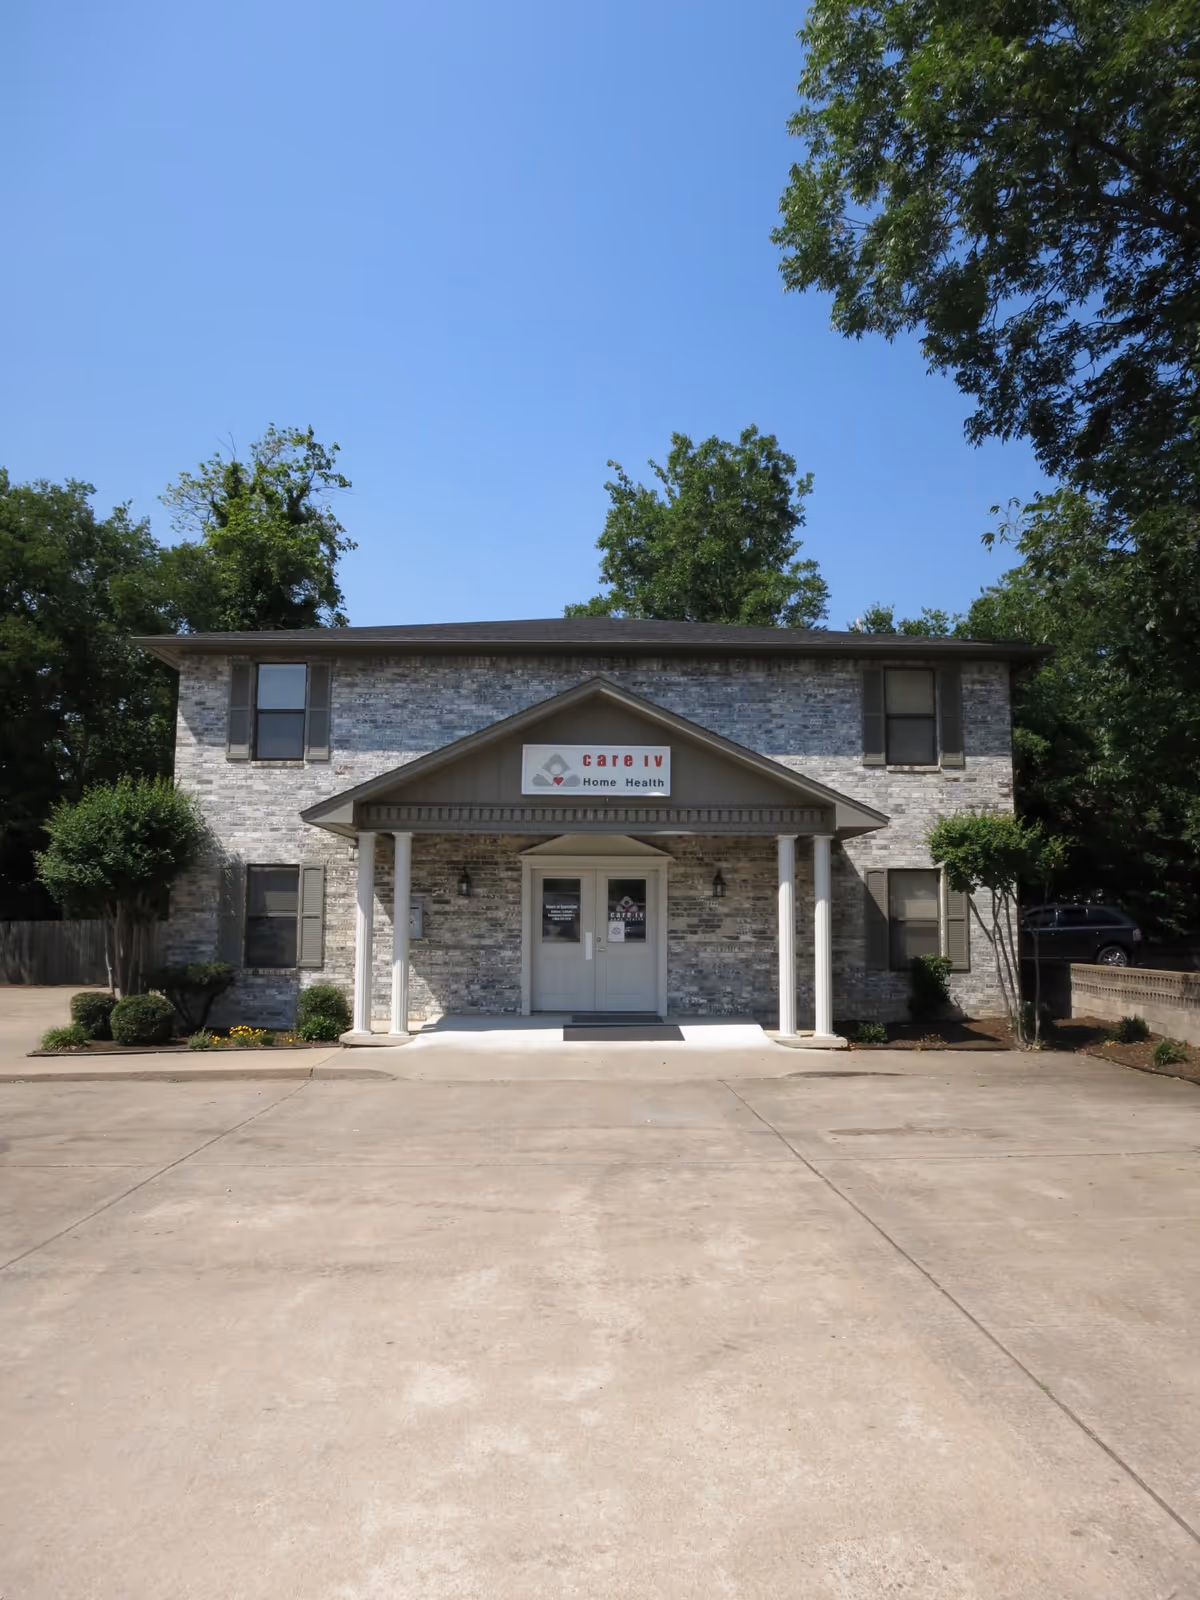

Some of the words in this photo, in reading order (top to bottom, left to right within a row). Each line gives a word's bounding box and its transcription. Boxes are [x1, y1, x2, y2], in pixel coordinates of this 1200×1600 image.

[582, 754, 633, 767] care
[583, 778, 617, 787] Home
[625, 778, 665, 788] Health
